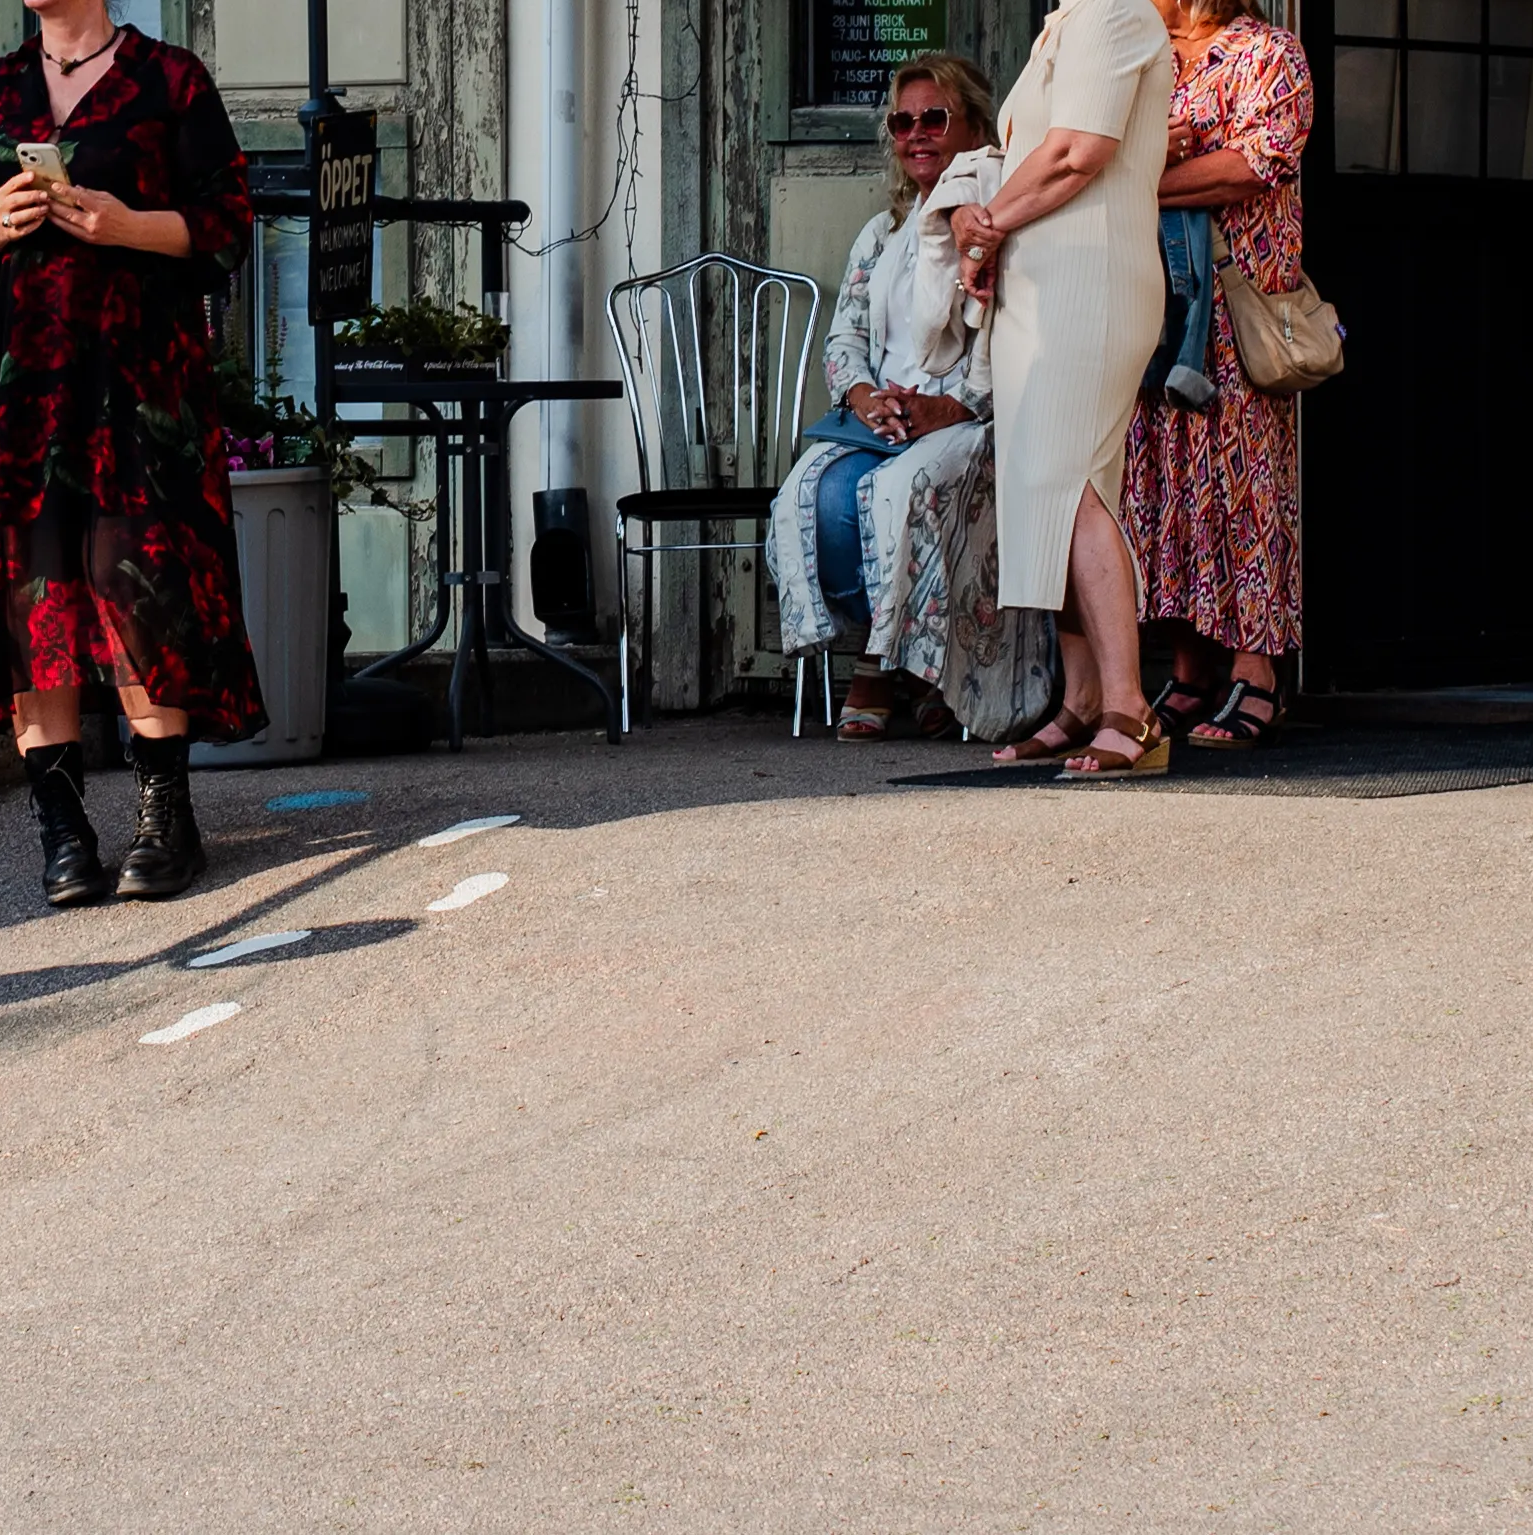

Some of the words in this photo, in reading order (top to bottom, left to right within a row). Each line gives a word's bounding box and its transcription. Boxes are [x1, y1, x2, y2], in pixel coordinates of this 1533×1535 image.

[874, 14, 906, 27] BRICK
[869, 49, 908, 62] KABUSA
[320, 142, 372, 211] ÖPPET
[319, 210, 373, 253] VÄLKOMMEN!
[319, 252, 368, 293] WELCOME!
